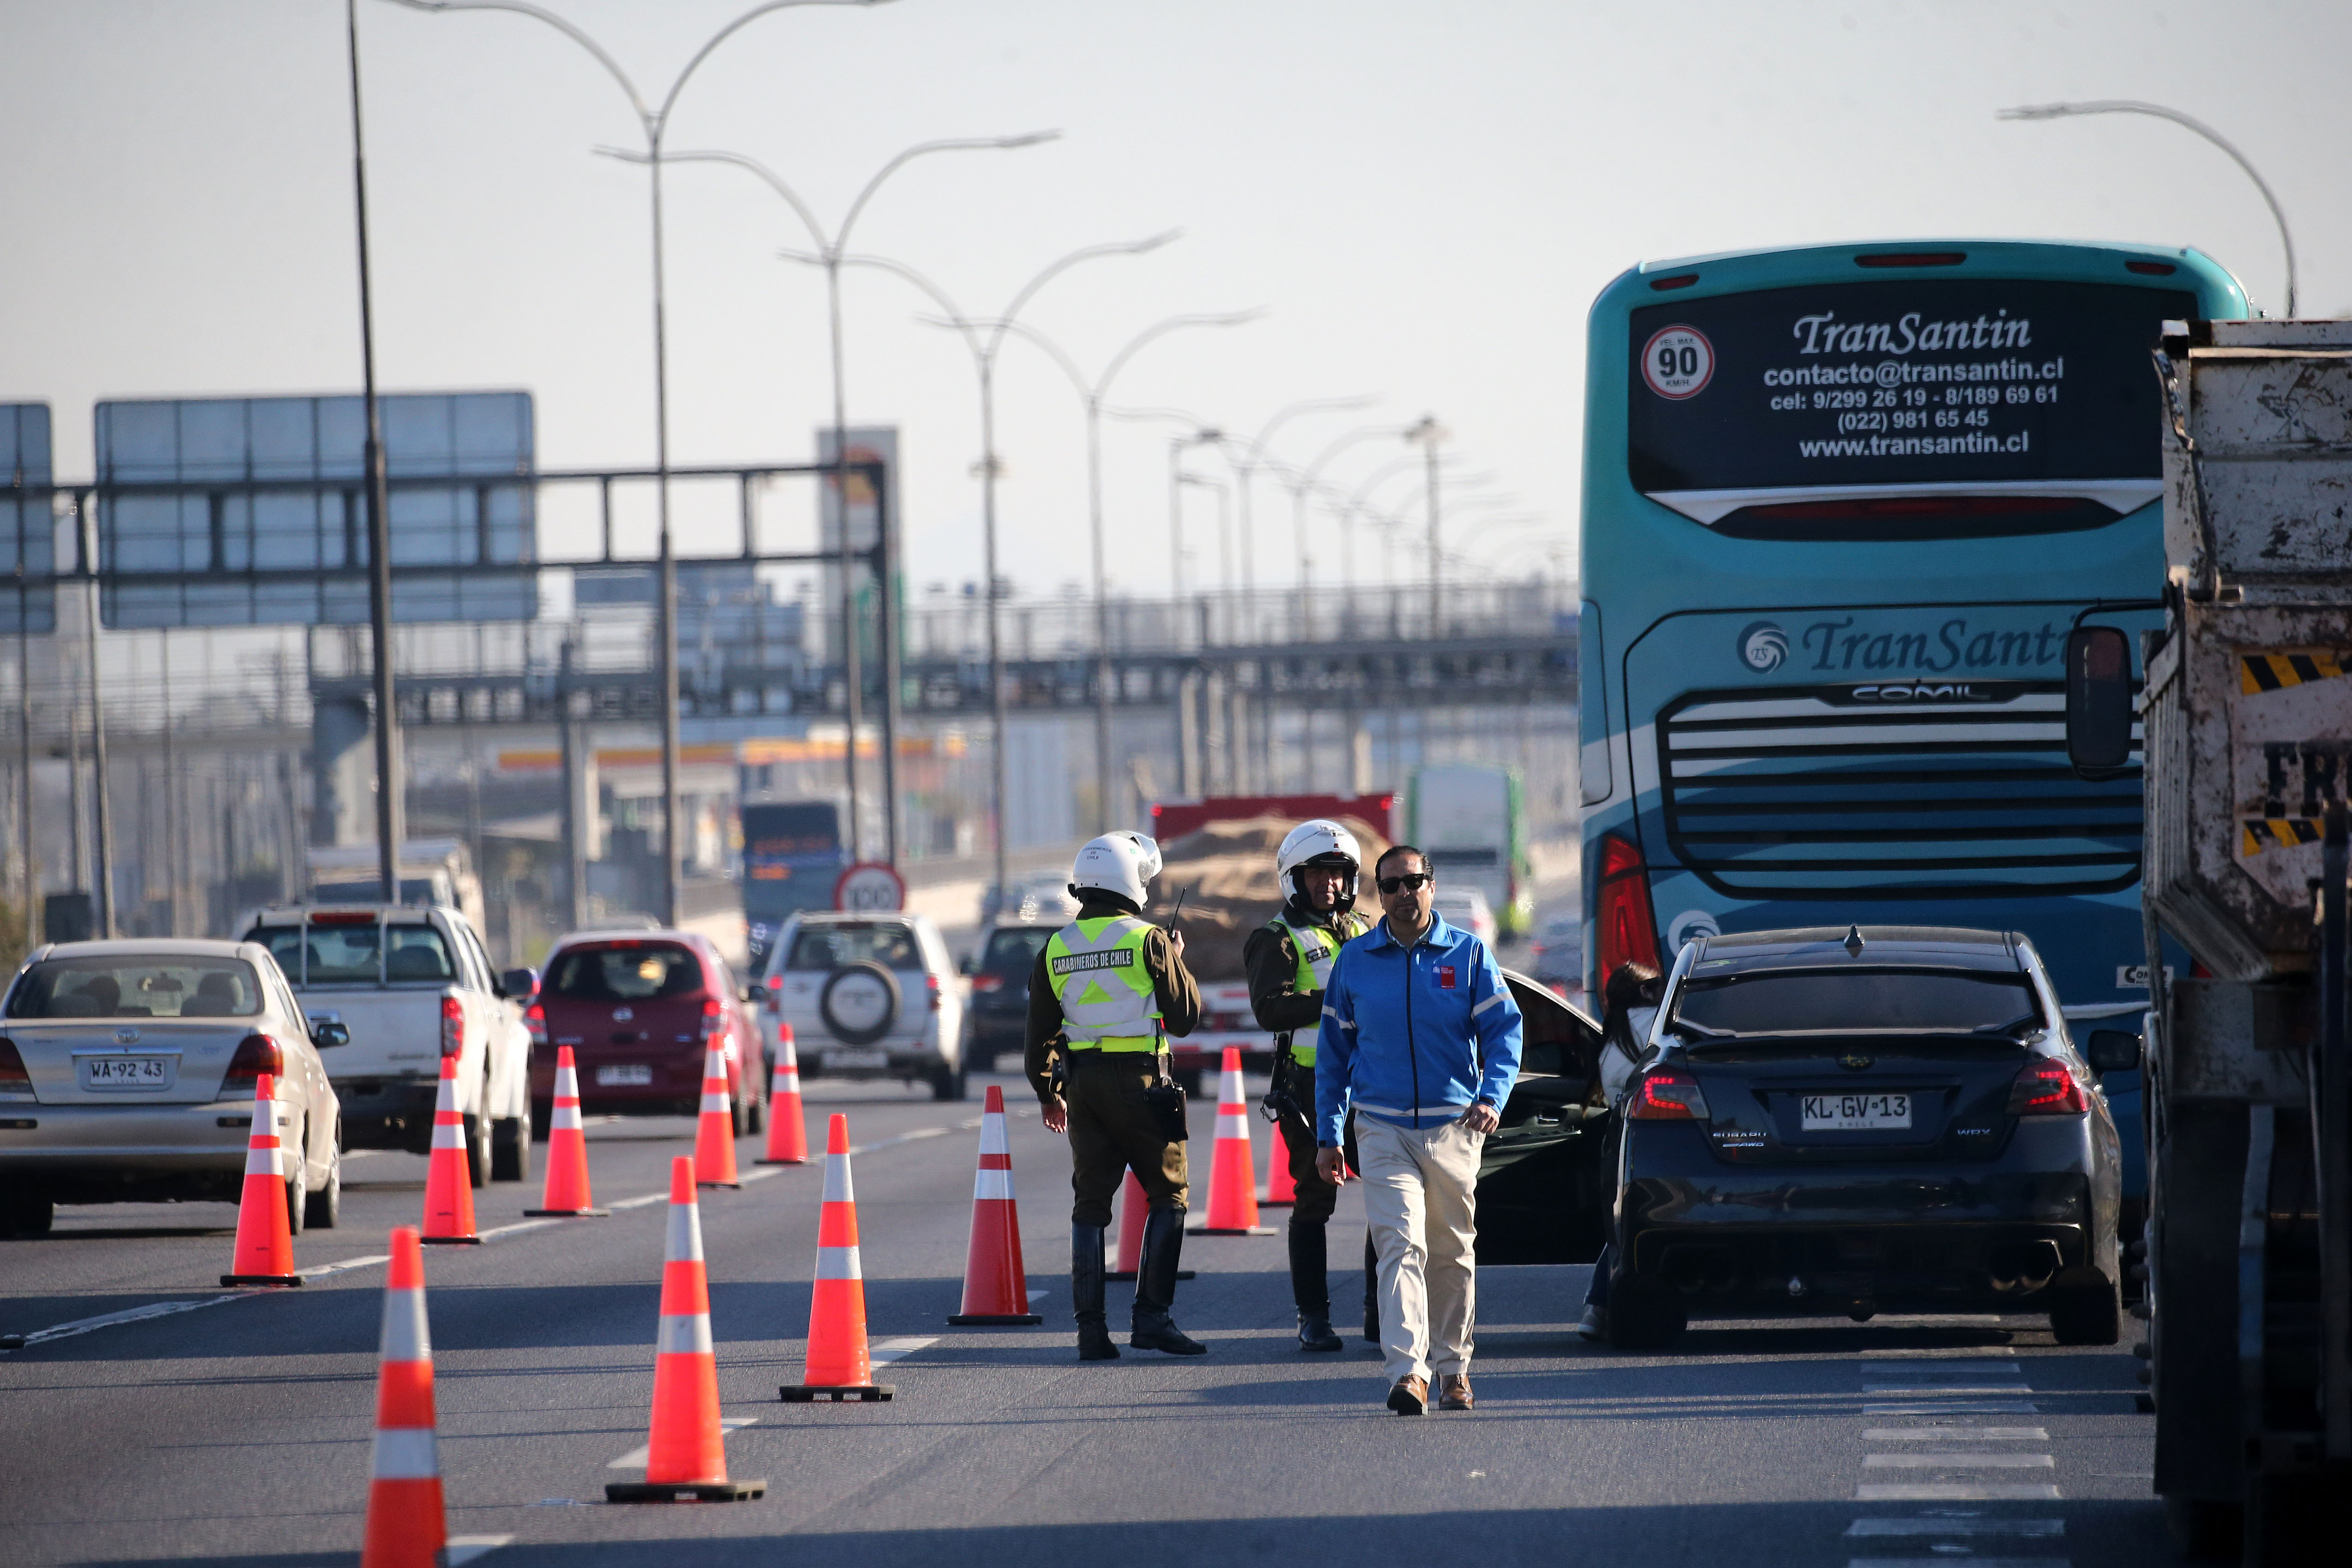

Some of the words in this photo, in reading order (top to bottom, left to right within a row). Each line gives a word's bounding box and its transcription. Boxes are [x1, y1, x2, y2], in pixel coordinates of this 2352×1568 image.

[1793, 308, 2032, 354] TranSantin
[1659, 347, 1697, 377] 90
[1763, 356, 2064, 388] contacto@transantin.cl
[1770, 391, 1806, 410] cel:
[1813, 390, 1867, 409] 9/299
[1872, 389, 1897, 407] 26
[1902, 387, 1926, 406] 19
[1945, 385, 2000, 405] 8/189
[2005, 385, 2030, 404] 69
[2035, 384, 2057, 403] 61
[1838, 412, 1888, 434] (022)
[1893, 409, 1927, 428] 981
[1935, 409, 1960, 427] 65
[1964, 408, 1990, 427] 45
[1799, 429, 2029, 457] www.transantin.cl
[1802, 615, 2076, 673] TranSanti
[1852, 685, 1991, 701] COMIL
[1053, 953, 1099, 973] CARABINEROS
[1101, 953, 1109, 967] DE
[1111, 951, 1131, 966] CHILE
